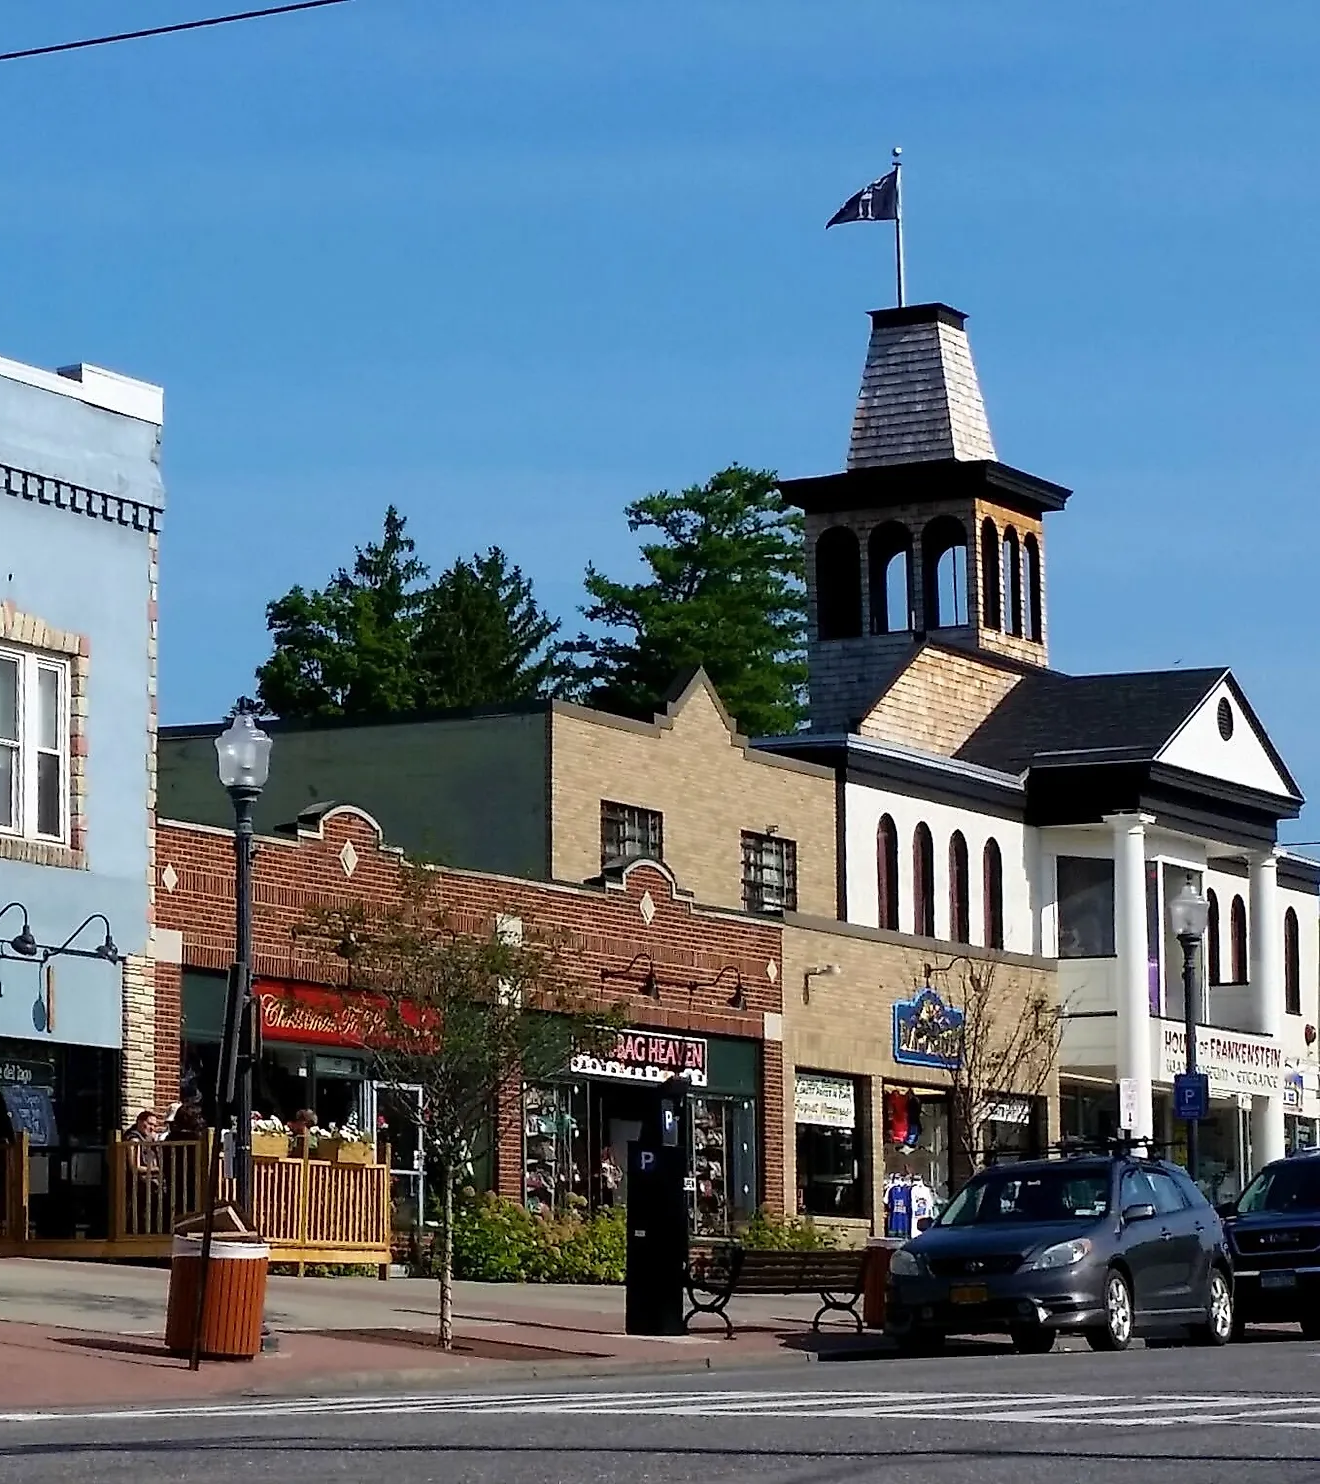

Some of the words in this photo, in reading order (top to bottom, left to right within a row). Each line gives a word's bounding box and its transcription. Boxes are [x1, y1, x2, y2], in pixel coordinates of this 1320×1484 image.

[648, 1037, 703, 1068] HEAVEN
[1210, 1038, 1282, 1068] FRANKENSTEIN
[1184, 1089, 1195, 1104] P
[664, 1110, 674, 1130] P
[640, 1151, 654, 1170] P
